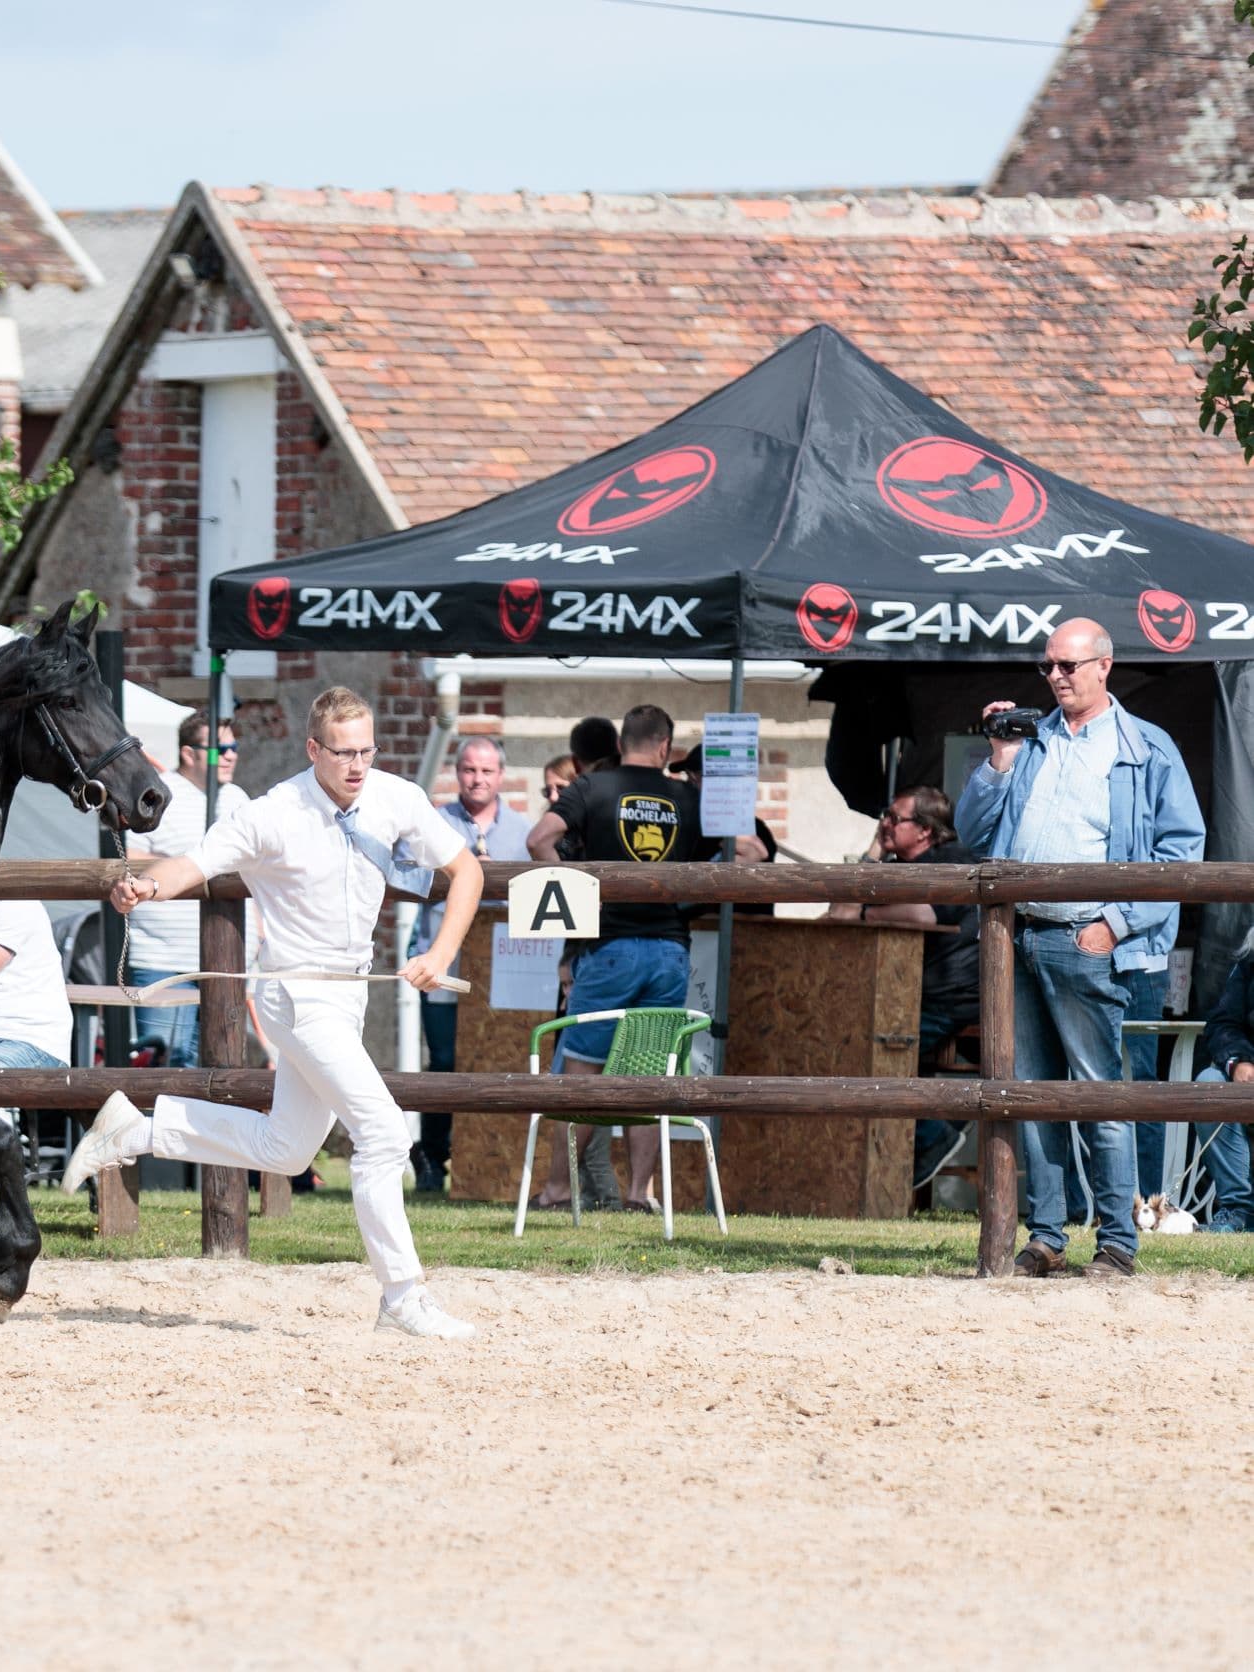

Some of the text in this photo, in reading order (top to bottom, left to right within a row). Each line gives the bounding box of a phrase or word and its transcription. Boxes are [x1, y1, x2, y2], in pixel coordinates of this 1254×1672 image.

[454, 542, 639, 565] 24MX
[919, 529, 1150, 574] 24MX
[298, 588, 443, 631] 24MX
[548, 590, 702, 638] 24MX
[865, 601, 1062, 644] 24MX
[620, 807, 678, 824] ROCHELAIS
[636, 800, 661, 811] STADE
[530, 880, 577, 931] A
[498, 937, 554, 957] BUVETTE
